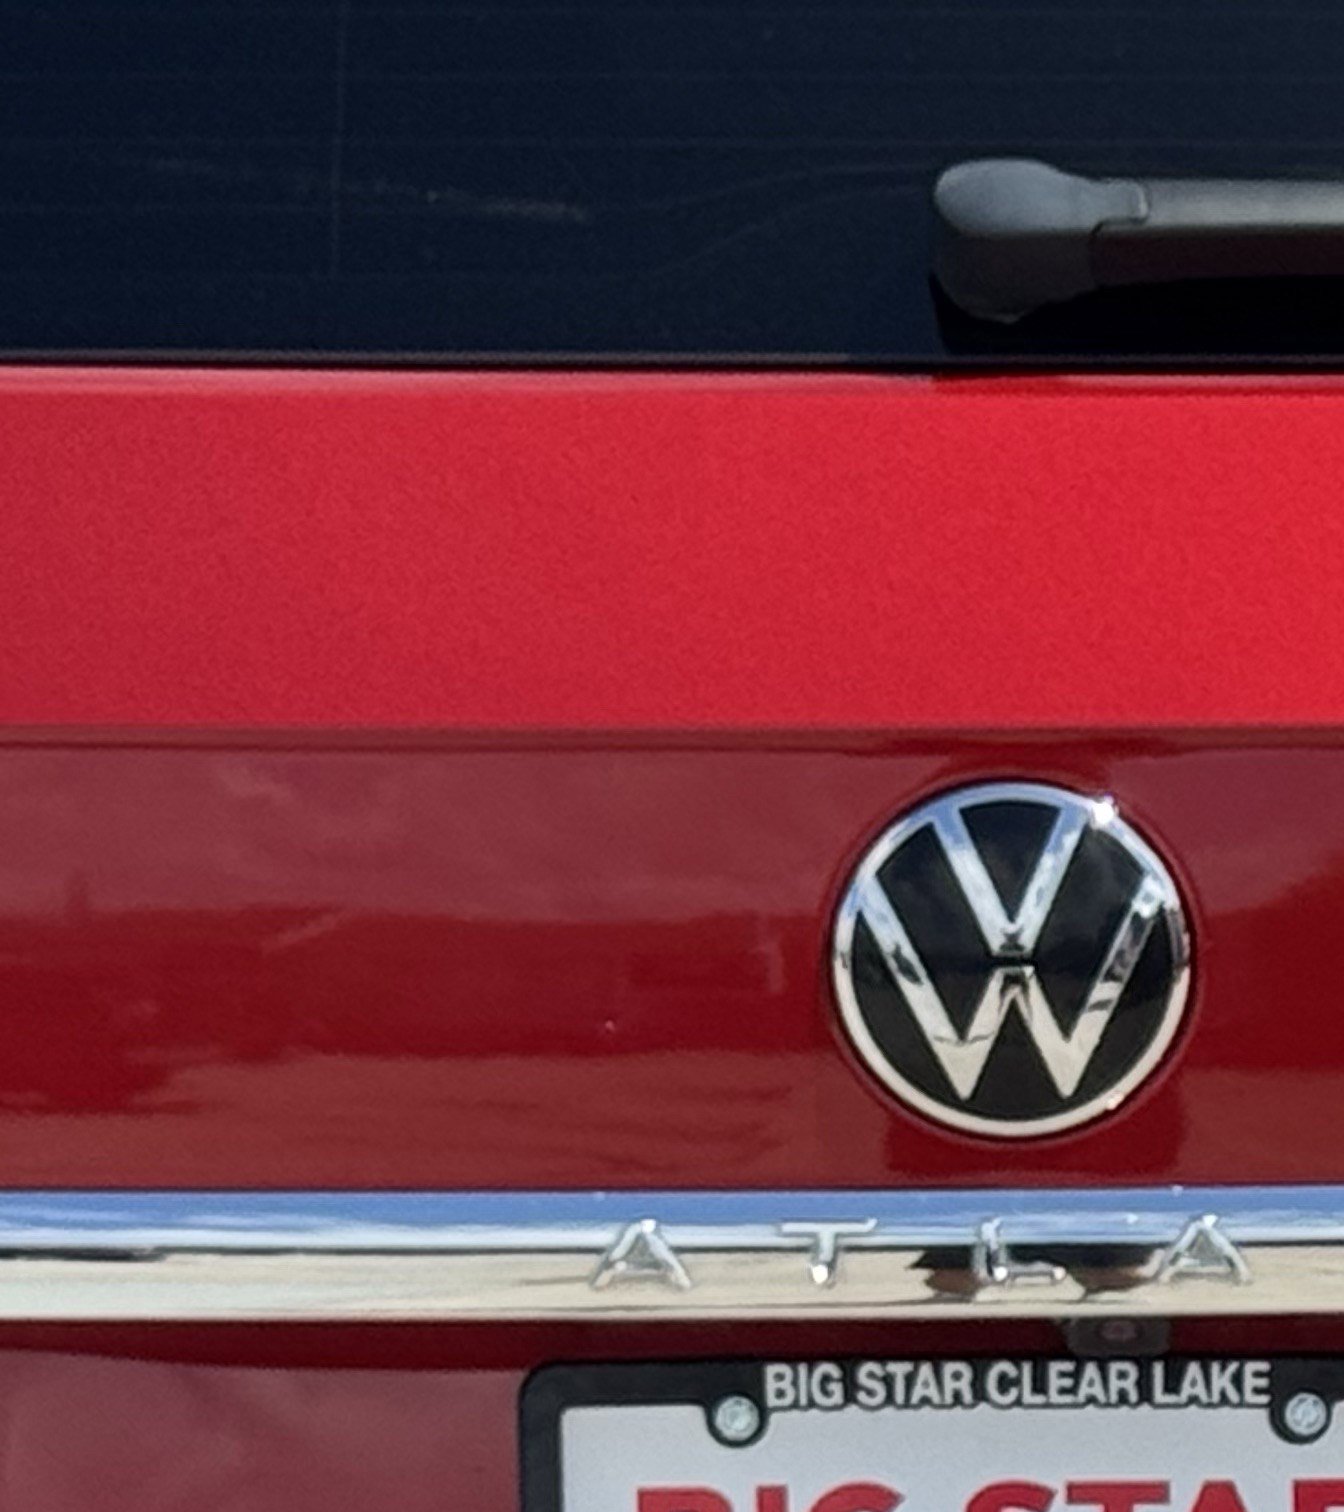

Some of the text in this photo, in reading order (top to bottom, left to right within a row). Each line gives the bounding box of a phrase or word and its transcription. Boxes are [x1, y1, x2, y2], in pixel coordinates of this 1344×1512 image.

[765, 1360, 1272, 1407] BIG STAR CLEAR LAKE
